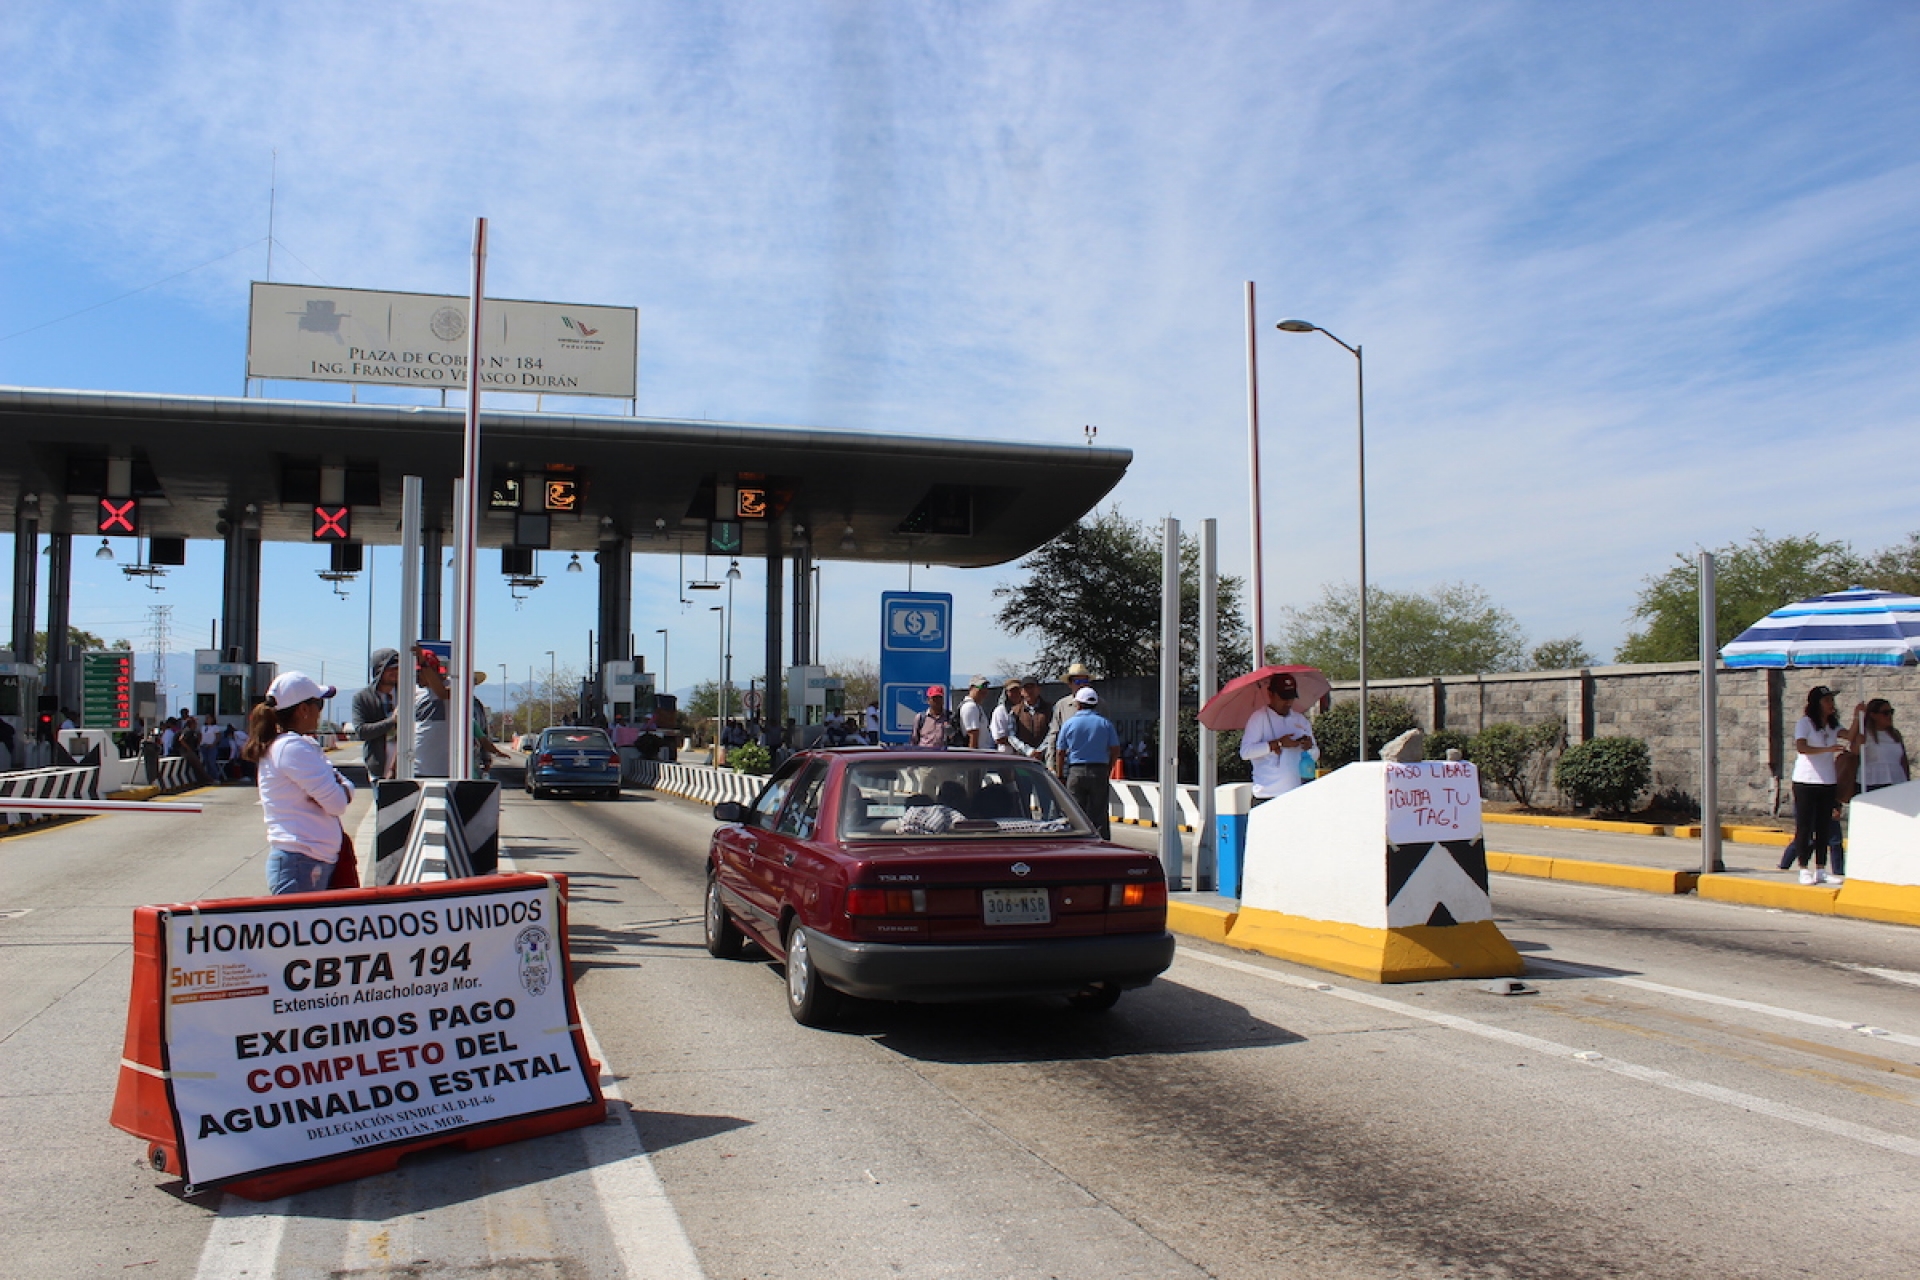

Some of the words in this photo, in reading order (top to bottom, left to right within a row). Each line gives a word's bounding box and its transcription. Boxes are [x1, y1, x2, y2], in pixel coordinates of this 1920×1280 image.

[311, 360, 347, 374] ING.
[352, 362, 444, 380] FRANCISCO
[450, 368, 516, 385] VEASCO
[522, 372, 579, 387] DURÁN
[349, 347, 397, 362] PLAZA
[402, 351, 423, 363] DE
[428, 351, 485, 366] COB
[517, 357, 543, 369] 184
[1386, 764, 1422, 782] PASO
[1430, 763, 1471, 778] LIBRE
[1443, 788, 1471, 805] TU
[1413, 806, 1459, 829] TAG!
[988, 897, 1046, 913] 306-NSB
[187, 910, 439, 954] HOMOLOGADOS
[446, 898, 542, 932] UNIDOS
[283, 951, 394, 992] CBTA
[409, 942, 472, 977] 194
[273, 991, 349, 1014] Extensión
[353, 981, 449, 1004] Atlacholoaya
[453, 976, 482, 991] Mor.
[235, 1012, 419, 1060] EXIGIMOS
[428, 997, 516, 1031] PAGO
[246, 1042, 445, 1094] COMPLETO
[455, 1031, 518, 1060] DEL
[198, 1081, 419, 1139] AGUINALDO
[429, 1053, 571, 1097] ESTATAL
[307, 1112, 395, 1140] DELEGACIÓN
[396, 1102, 458, 1122] SINDICAL
[351, 1120, 435, 1147] MIACATLÁN,
[434, 1114, 470, 1129] MOR.
